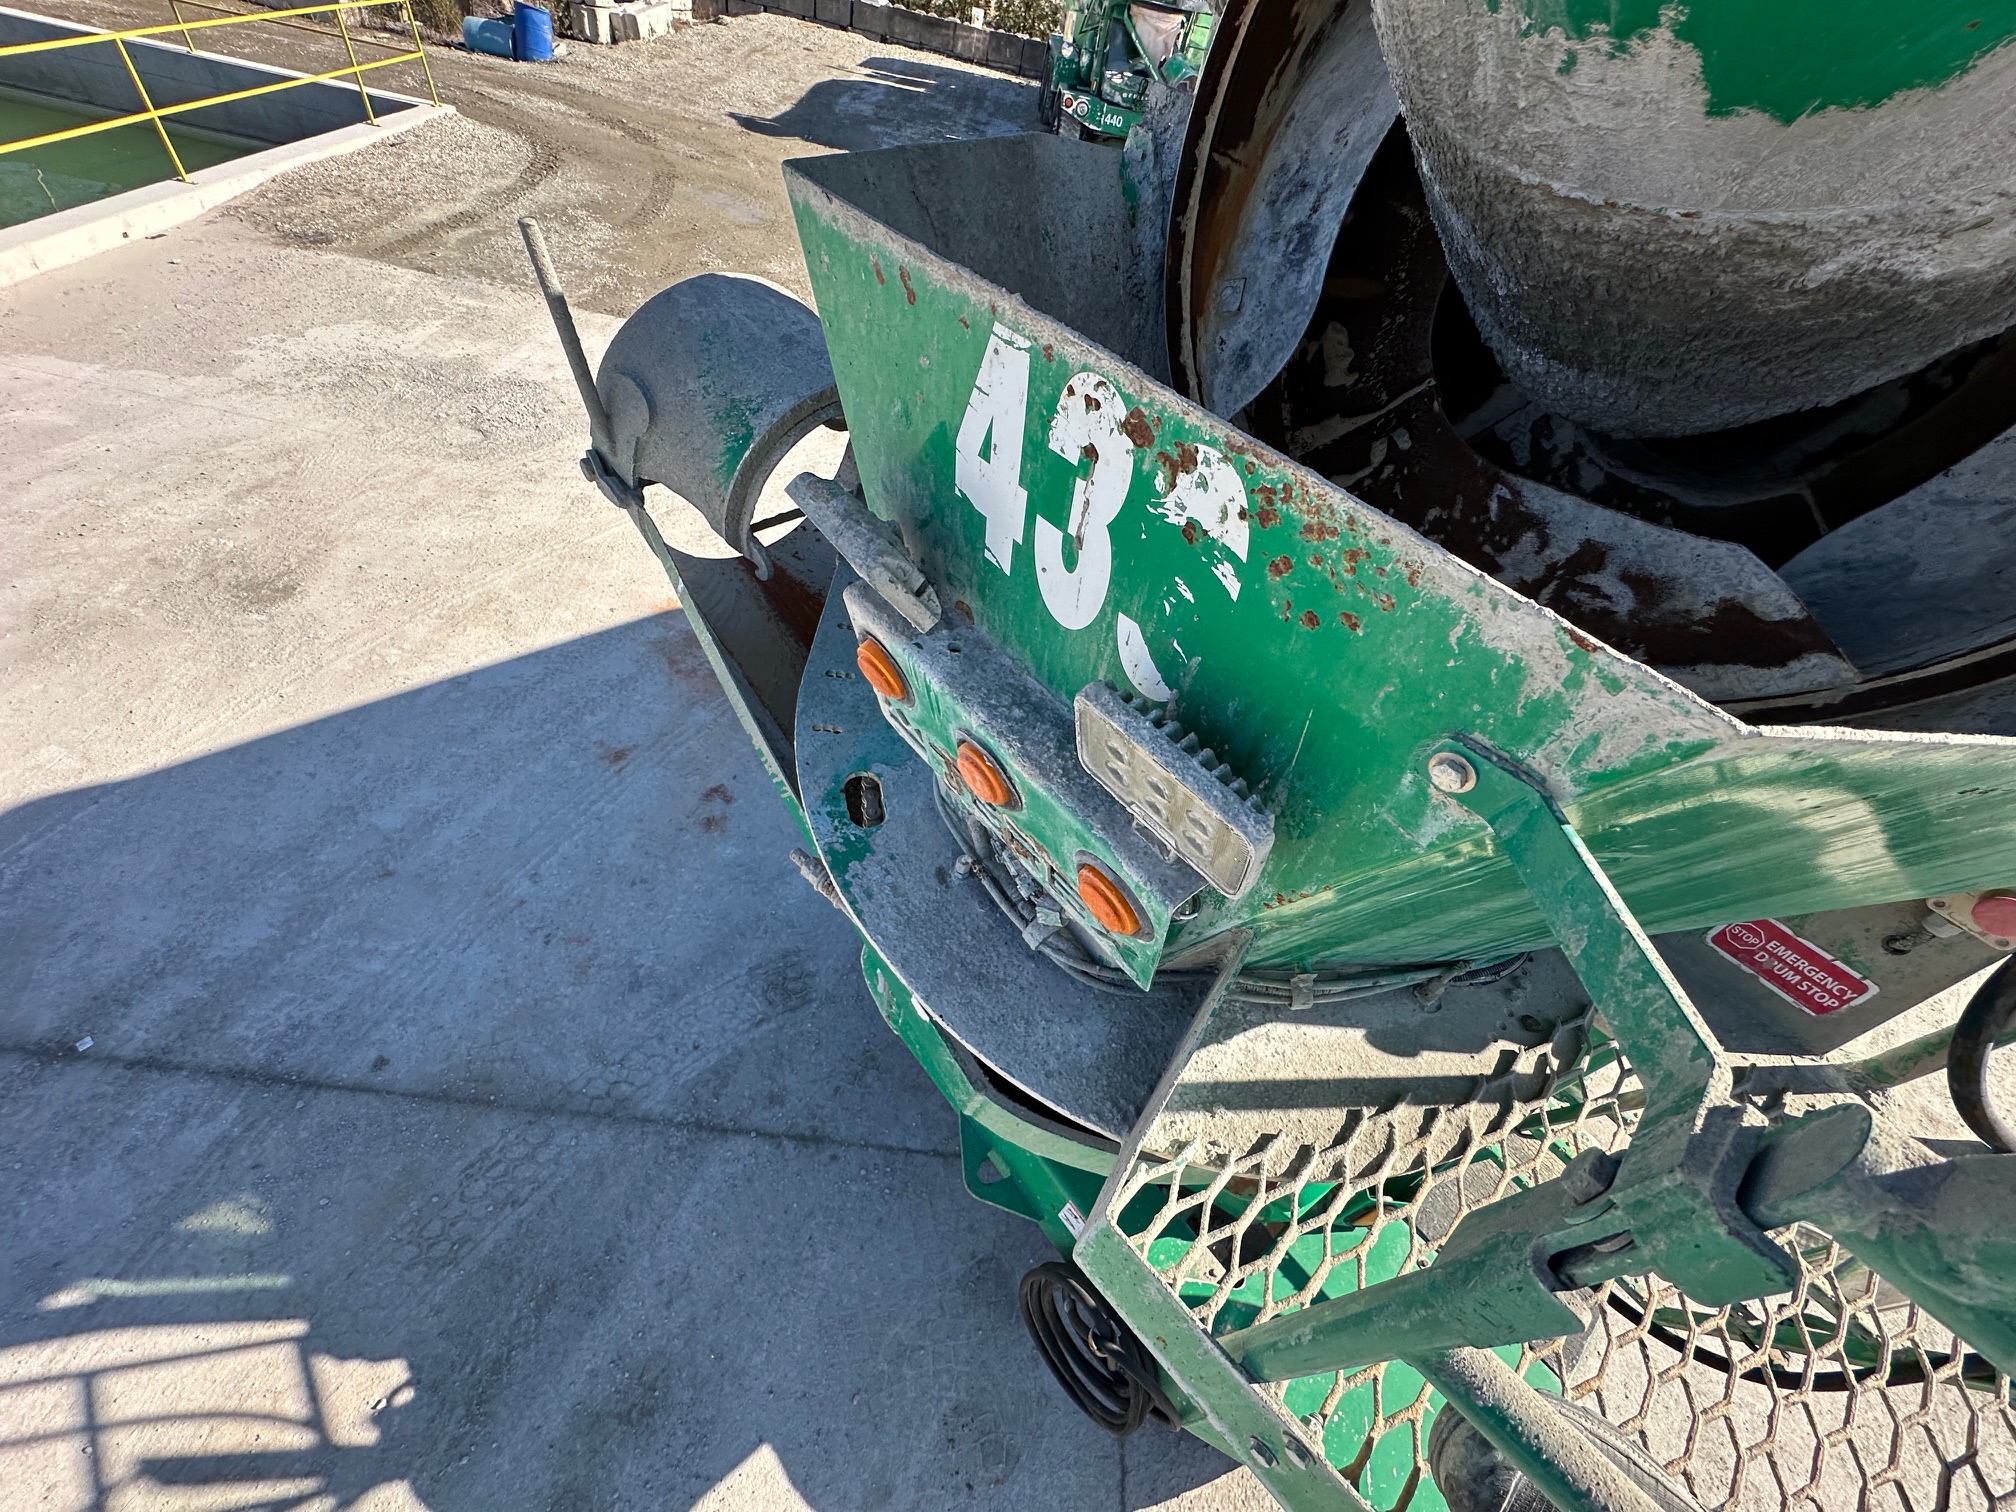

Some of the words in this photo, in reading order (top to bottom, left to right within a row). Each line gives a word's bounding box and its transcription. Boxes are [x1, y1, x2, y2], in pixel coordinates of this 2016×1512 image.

[1731, 925, 1760, 944] STOP
[1753, 951, 1801, 984] DUM
[1797, 981, 1839, 1007] STOP
[1765, 940, 1858, 1000] EMERGENCY
